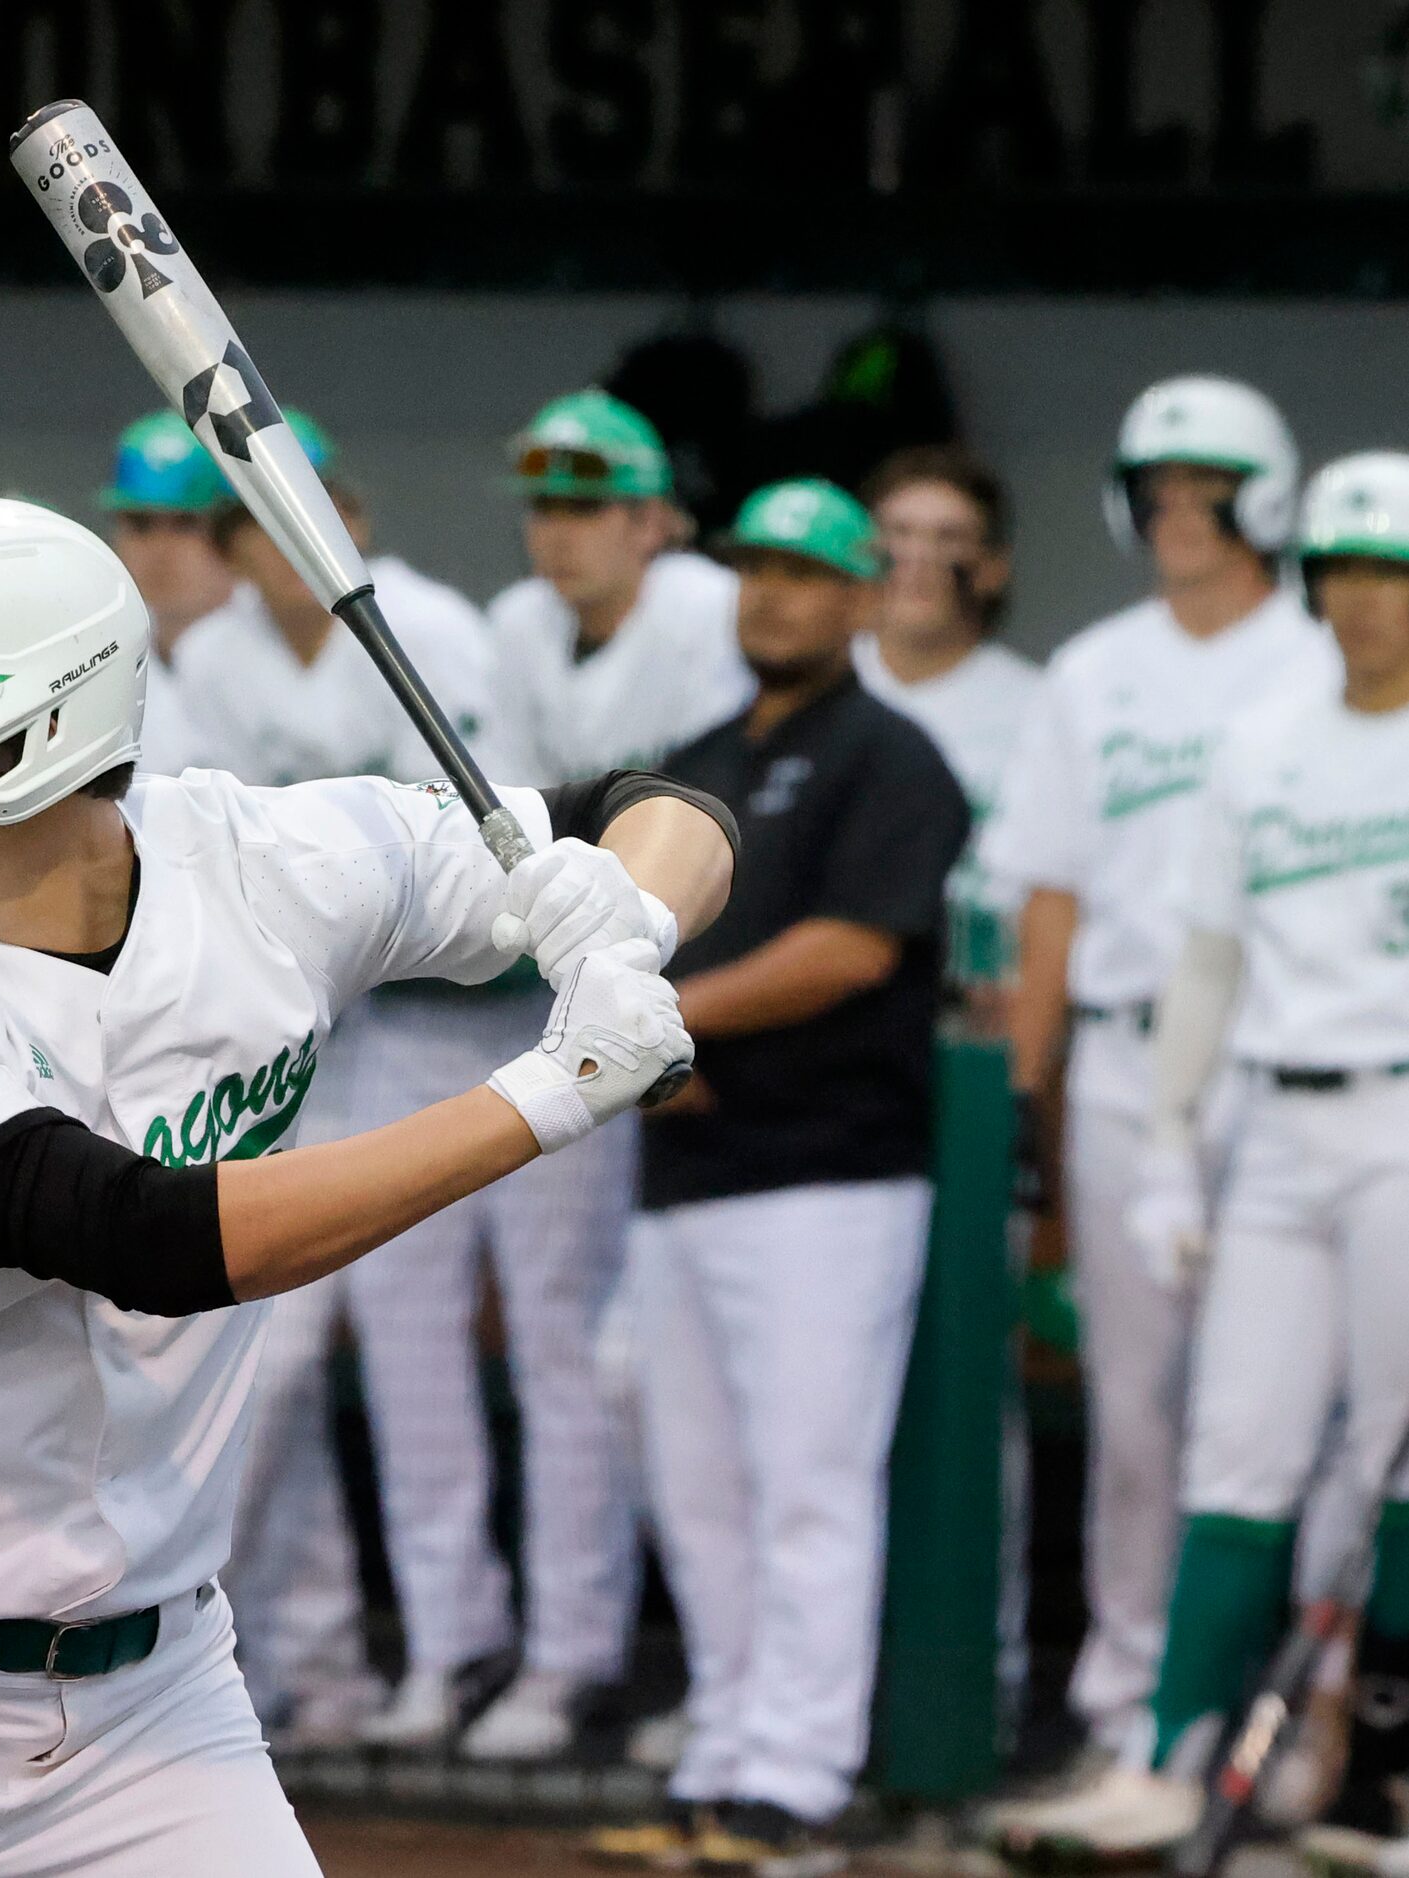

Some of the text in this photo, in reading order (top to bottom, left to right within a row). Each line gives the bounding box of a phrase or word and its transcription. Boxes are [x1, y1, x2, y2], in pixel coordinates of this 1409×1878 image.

[38, 140, 111, 191] GOODS
[49, 134, 75, 160] The
[48, 640, 120, 693] RAWLINGS
[144, 1029, 317, 1169] agons
